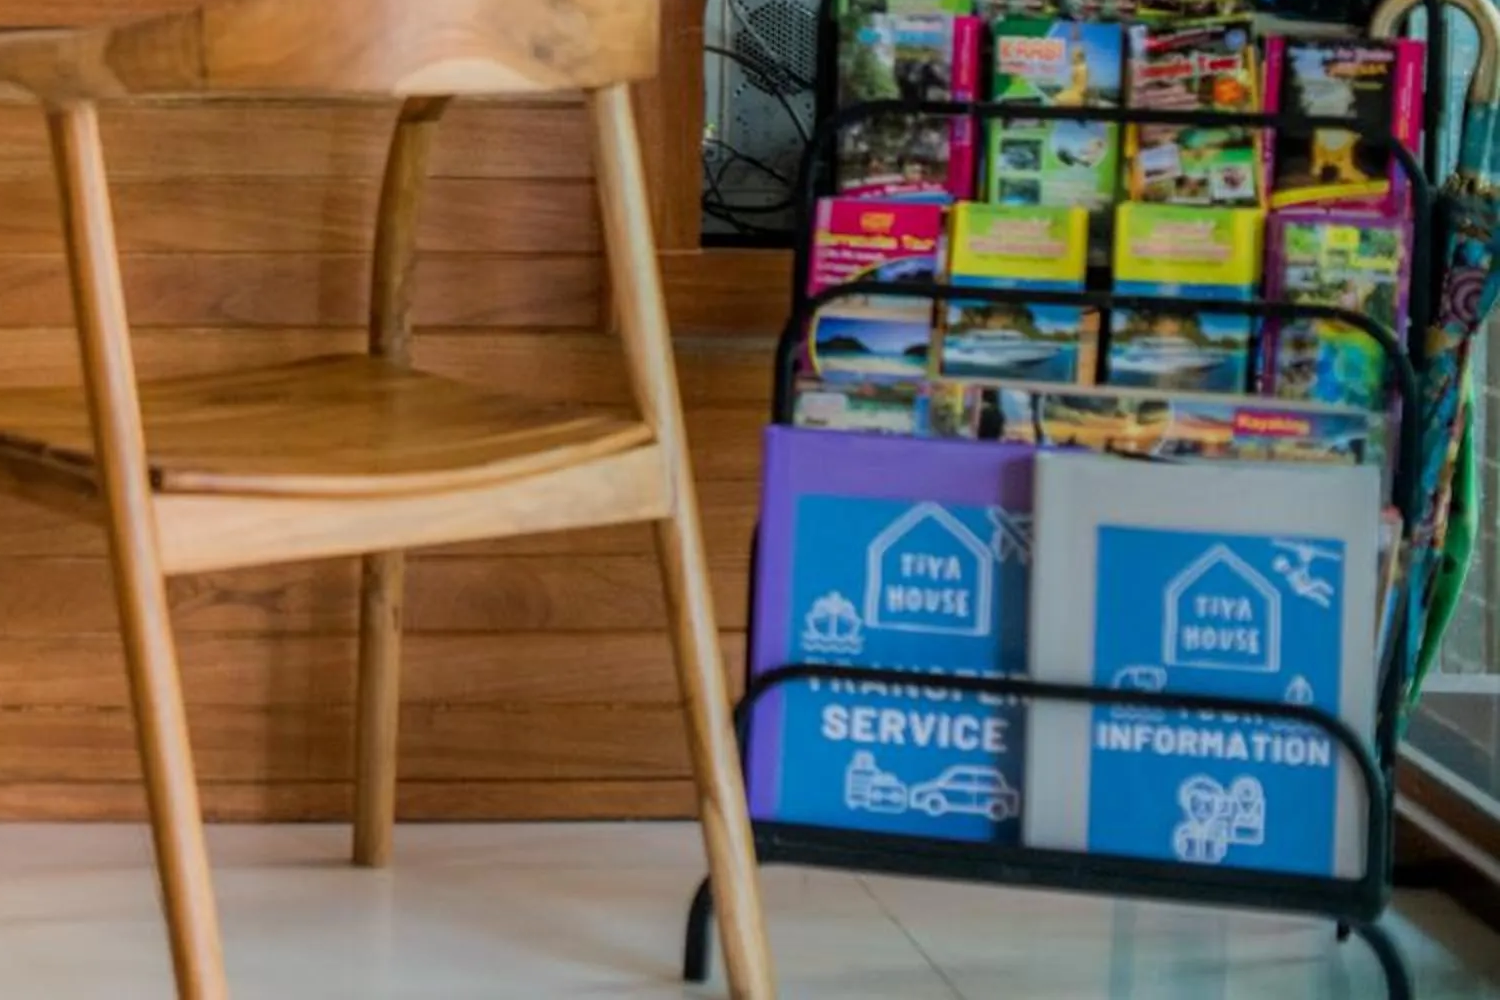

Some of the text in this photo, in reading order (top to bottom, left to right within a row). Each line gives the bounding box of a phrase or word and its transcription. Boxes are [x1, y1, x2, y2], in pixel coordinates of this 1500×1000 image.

[885, 584, 970, 618] HOUSE
[1182, 626, 1261, 655] HOUSE
[821, 703, 1009, 754] SERVICE
[1097, 721, 1331, 768] INFORMATION
